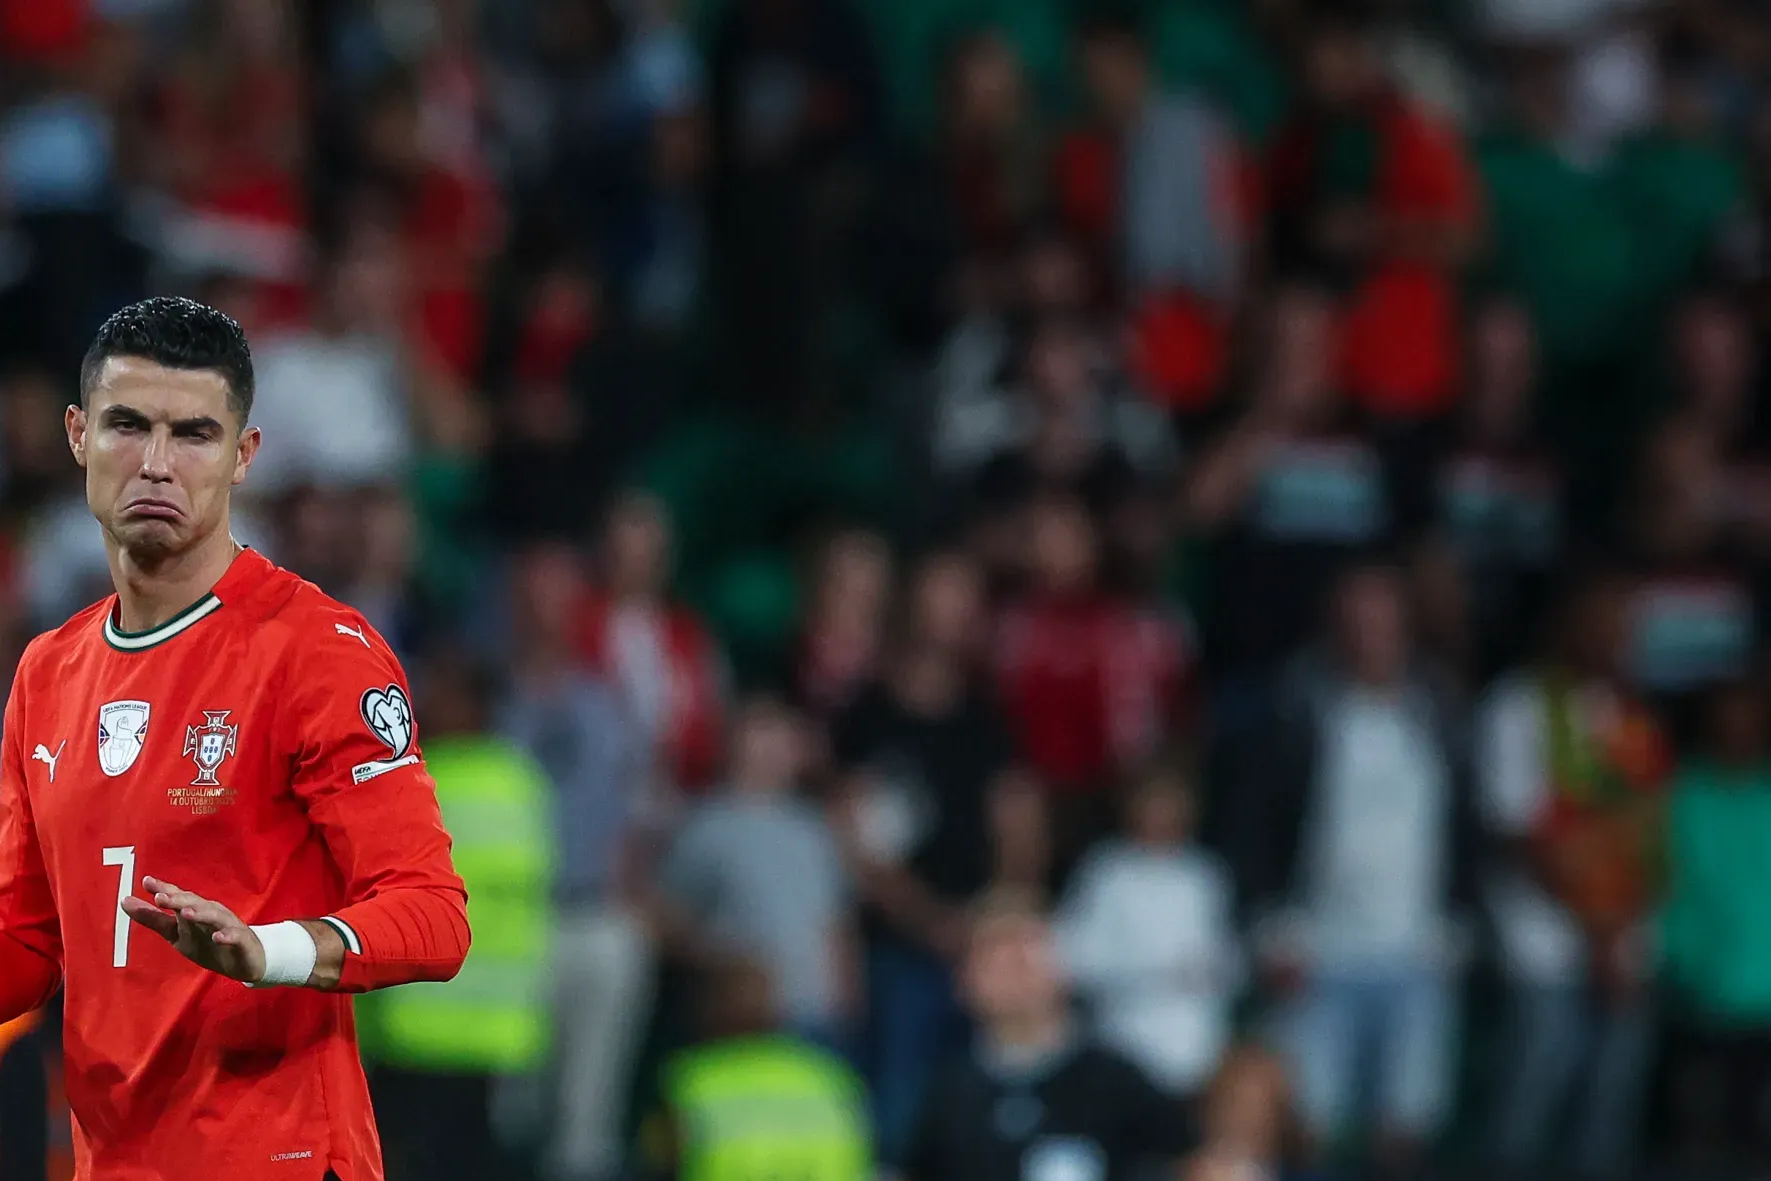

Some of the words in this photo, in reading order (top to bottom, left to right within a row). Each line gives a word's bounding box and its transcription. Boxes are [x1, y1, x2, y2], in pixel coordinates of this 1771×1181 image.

[354, 765, 371, 775] UEFA
[170, 797, 178, 806] 14
[178, 797, 214, 806] OUTUBRO
[103, 846, 135, 967] 7
[270, 1150, 312, 1162] ULTRAWEAVE
